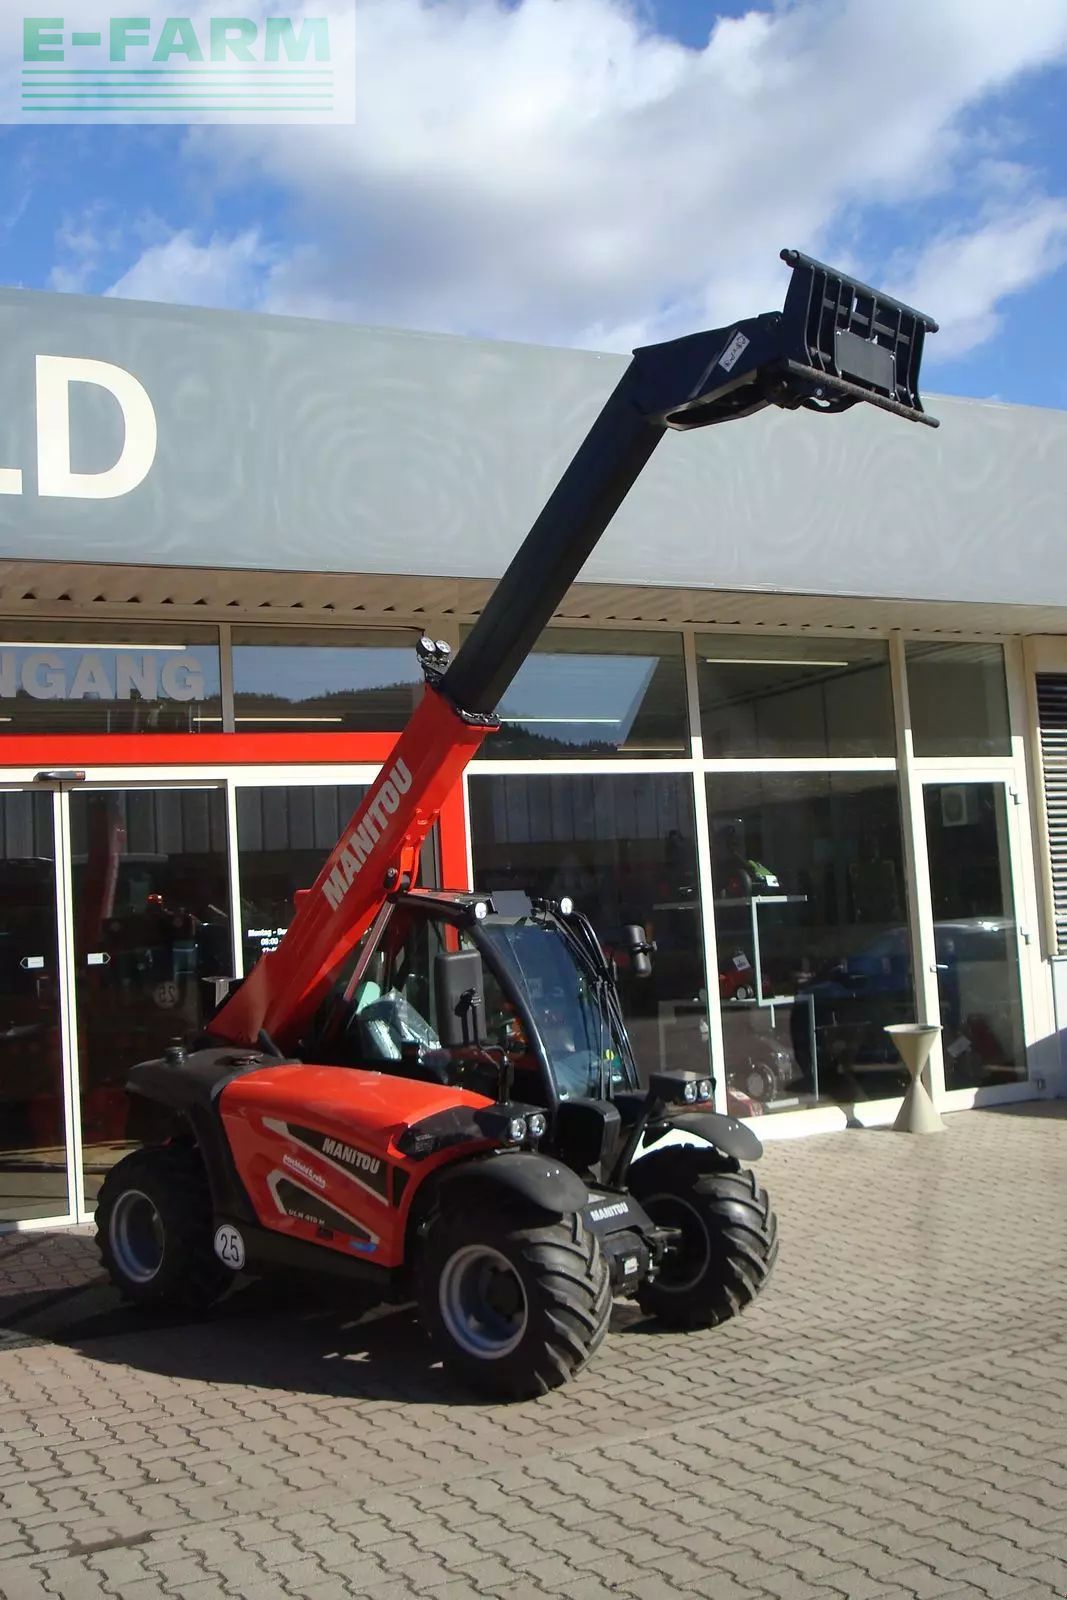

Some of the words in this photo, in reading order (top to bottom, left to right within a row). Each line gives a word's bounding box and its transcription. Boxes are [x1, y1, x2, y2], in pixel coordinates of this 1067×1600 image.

[0, 354, 157, 499] D
[321, 757, 413, 911] MANITOU
[321, 1137, 380, 1175] MANITOU
[590, 1201, 629, 1222] MANITOU
[220, 1233, 239, 1263] 25
